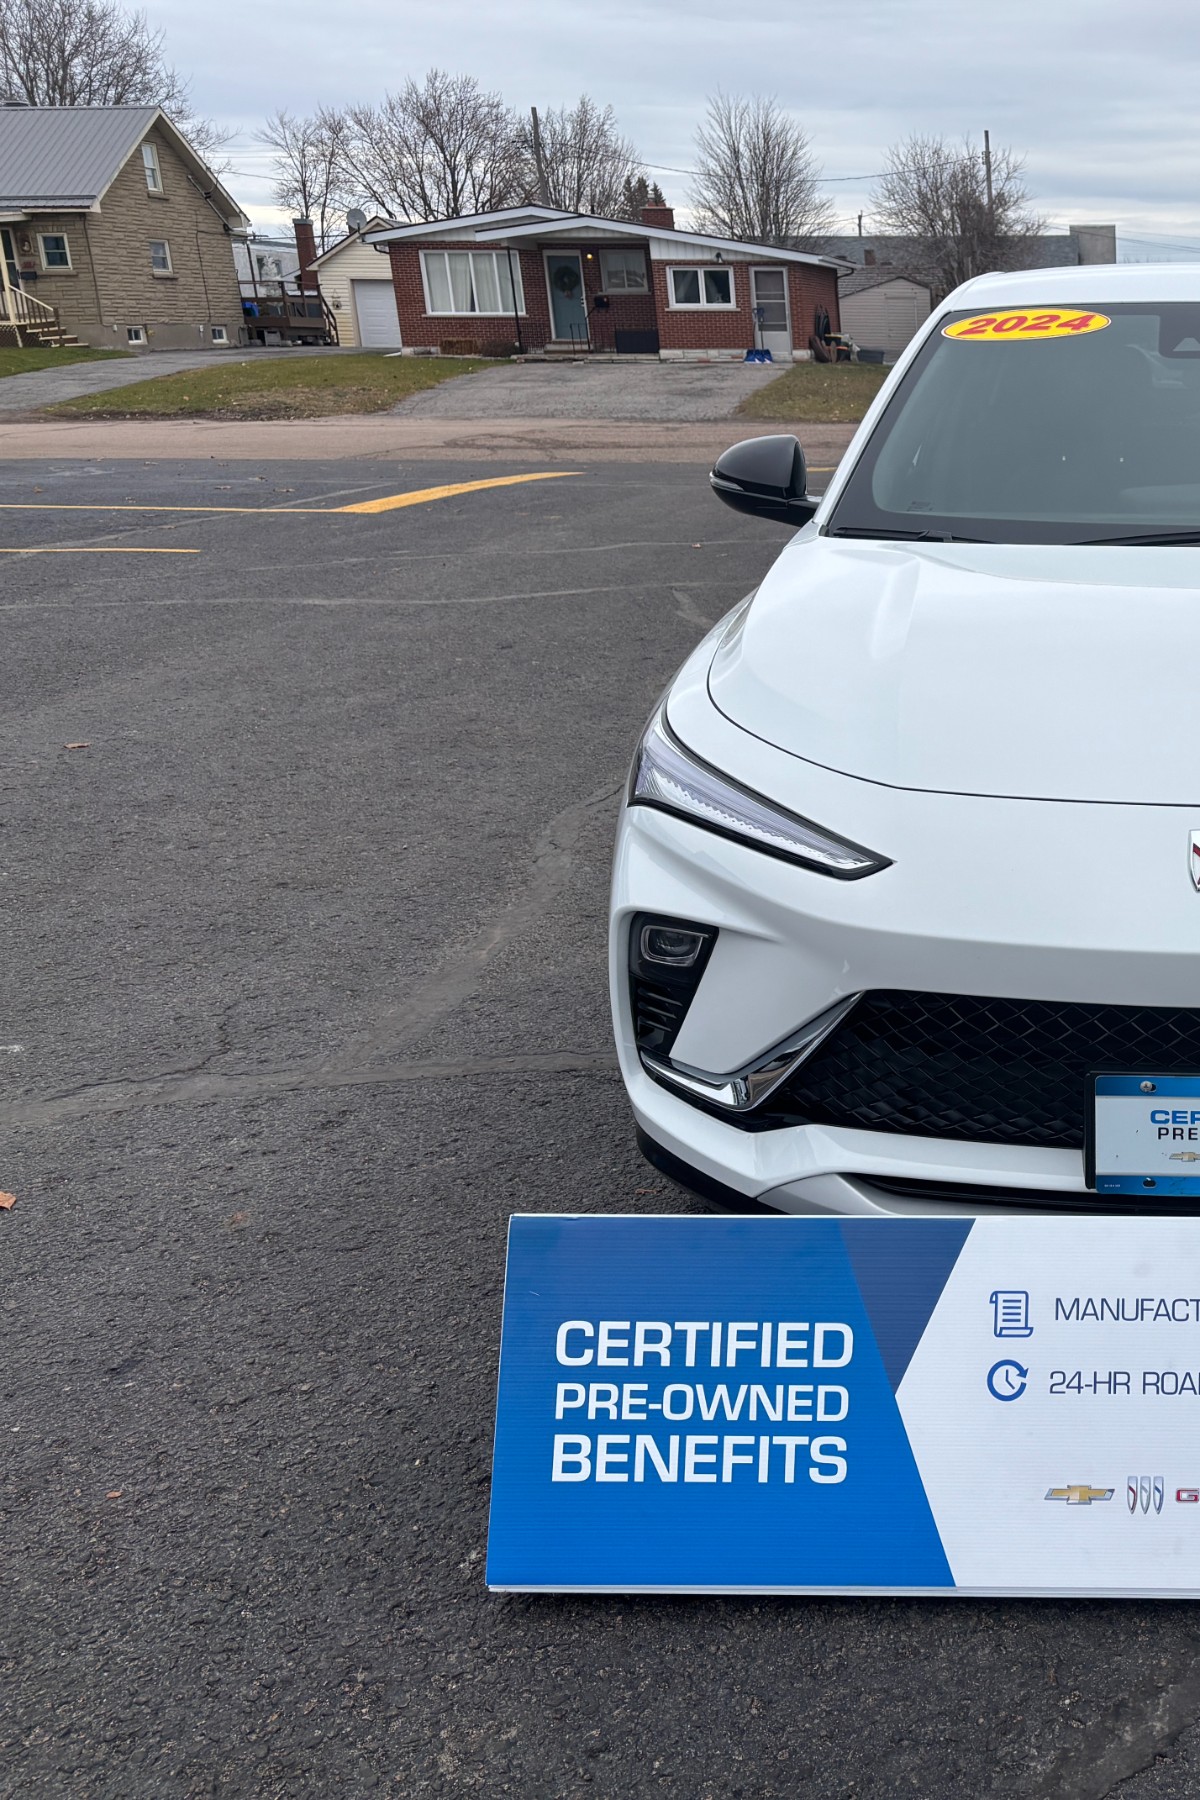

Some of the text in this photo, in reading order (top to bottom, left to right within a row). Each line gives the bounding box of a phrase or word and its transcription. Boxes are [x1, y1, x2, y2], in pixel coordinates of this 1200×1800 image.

[956, 314, 1097, 336] 2024
[556, 1321, 853, 1367] CERTIFIED
[1050, 1371, 1130, 1394] 24-HR
[556, 1383, 848, 1421] PRE-OWNED
[552, 1435, 847, 1483] BENEFITS
